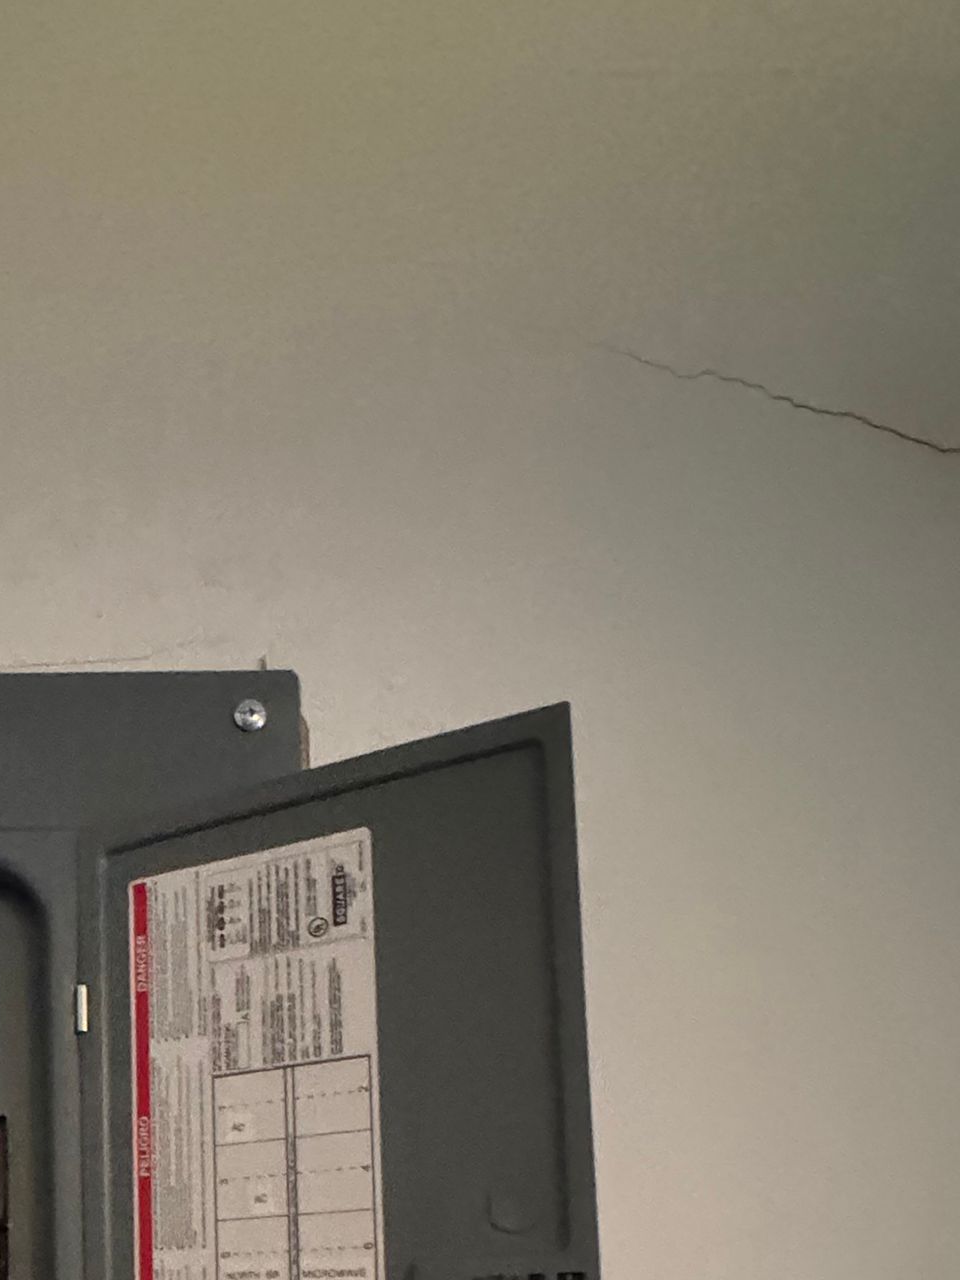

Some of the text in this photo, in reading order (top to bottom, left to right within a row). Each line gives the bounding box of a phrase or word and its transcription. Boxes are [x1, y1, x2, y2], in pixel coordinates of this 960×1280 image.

[136, 935, 147, 992] DANGER
[139, 1116, 150, 1177] PELIGRO
[302, 1268, 366, 1278] MICROWAVE
